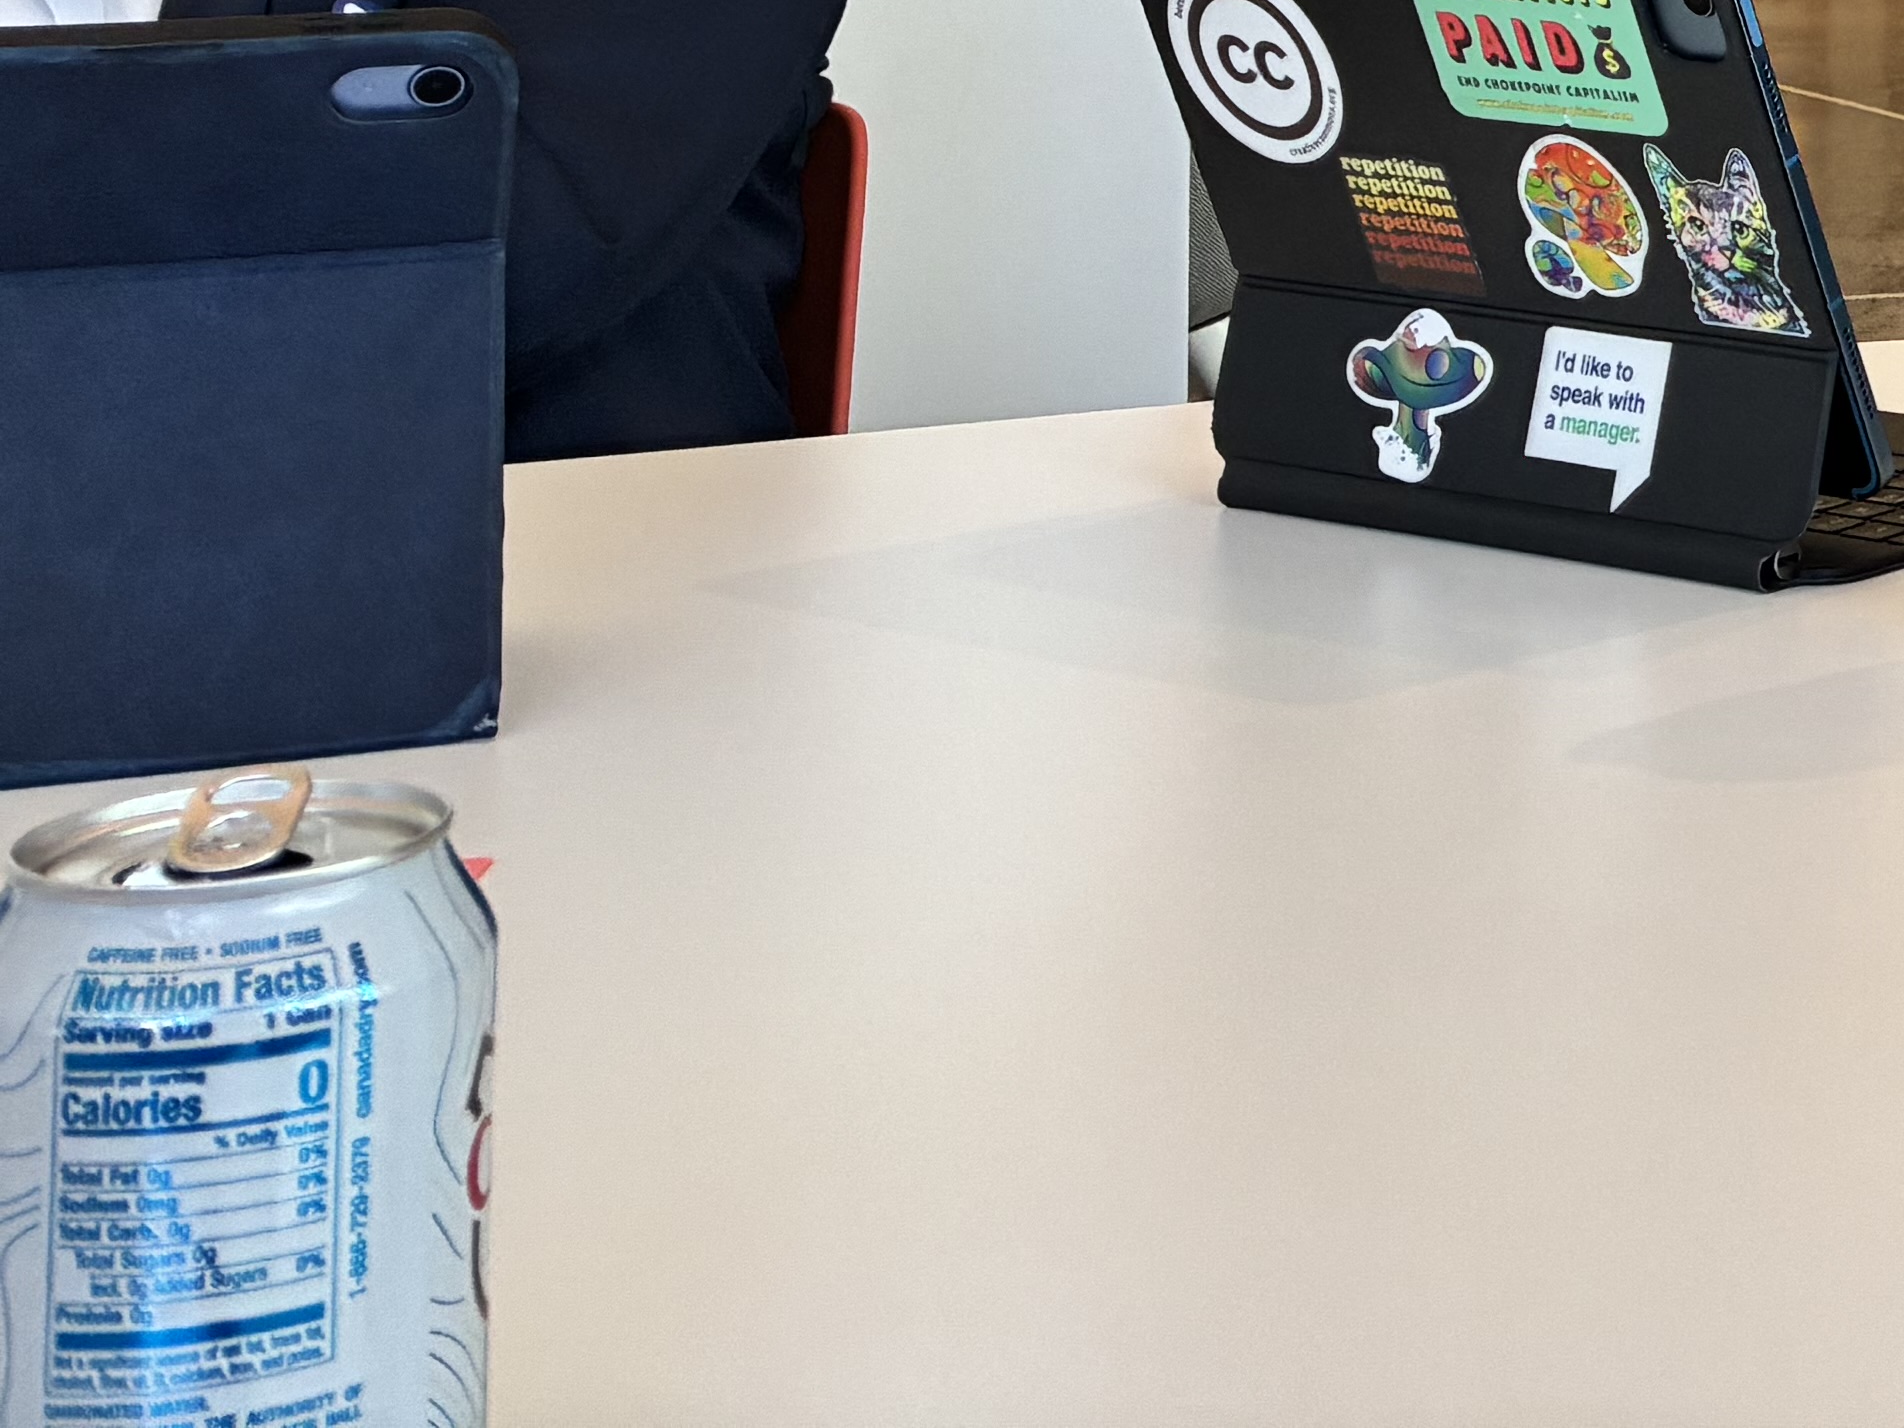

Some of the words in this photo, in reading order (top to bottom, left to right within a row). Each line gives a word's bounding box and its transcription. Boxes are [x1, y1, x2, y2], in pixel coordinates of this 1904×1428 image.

[1436, 11, 1585, 74] PAID
[1217, 34, 1295, 90] CC
[1457, 75, 1480, 89] END
[1484, 78, 1561, 96] CHOKEPOINT
[1566, 85, 1640, 103] CAPITALISM
[1339, 156, 1445, 182] repetition
[1345, 174, 1451, 200] repetition
[1352, 194, 1458, 219] repetition
[1360, 212, 1464, 237] repetition
[1555, 350, 1576, 373] I'd
[1580, 354, 1611, 379] like
[1616, 361, 1633, 382] to
[1550, 384, 1603, 407] speak
[1608, 390, 1645, 414] with
[1544, 413, 1555, 430] a
[1559, 415, 1640, 445] manager.
[71, 976, 221, 1012] Nutrition
[233, 960, 327, 1004] Facts
[61, 1091, 202, 1126] Calories
[298, 1059, 329, 1105] 0
